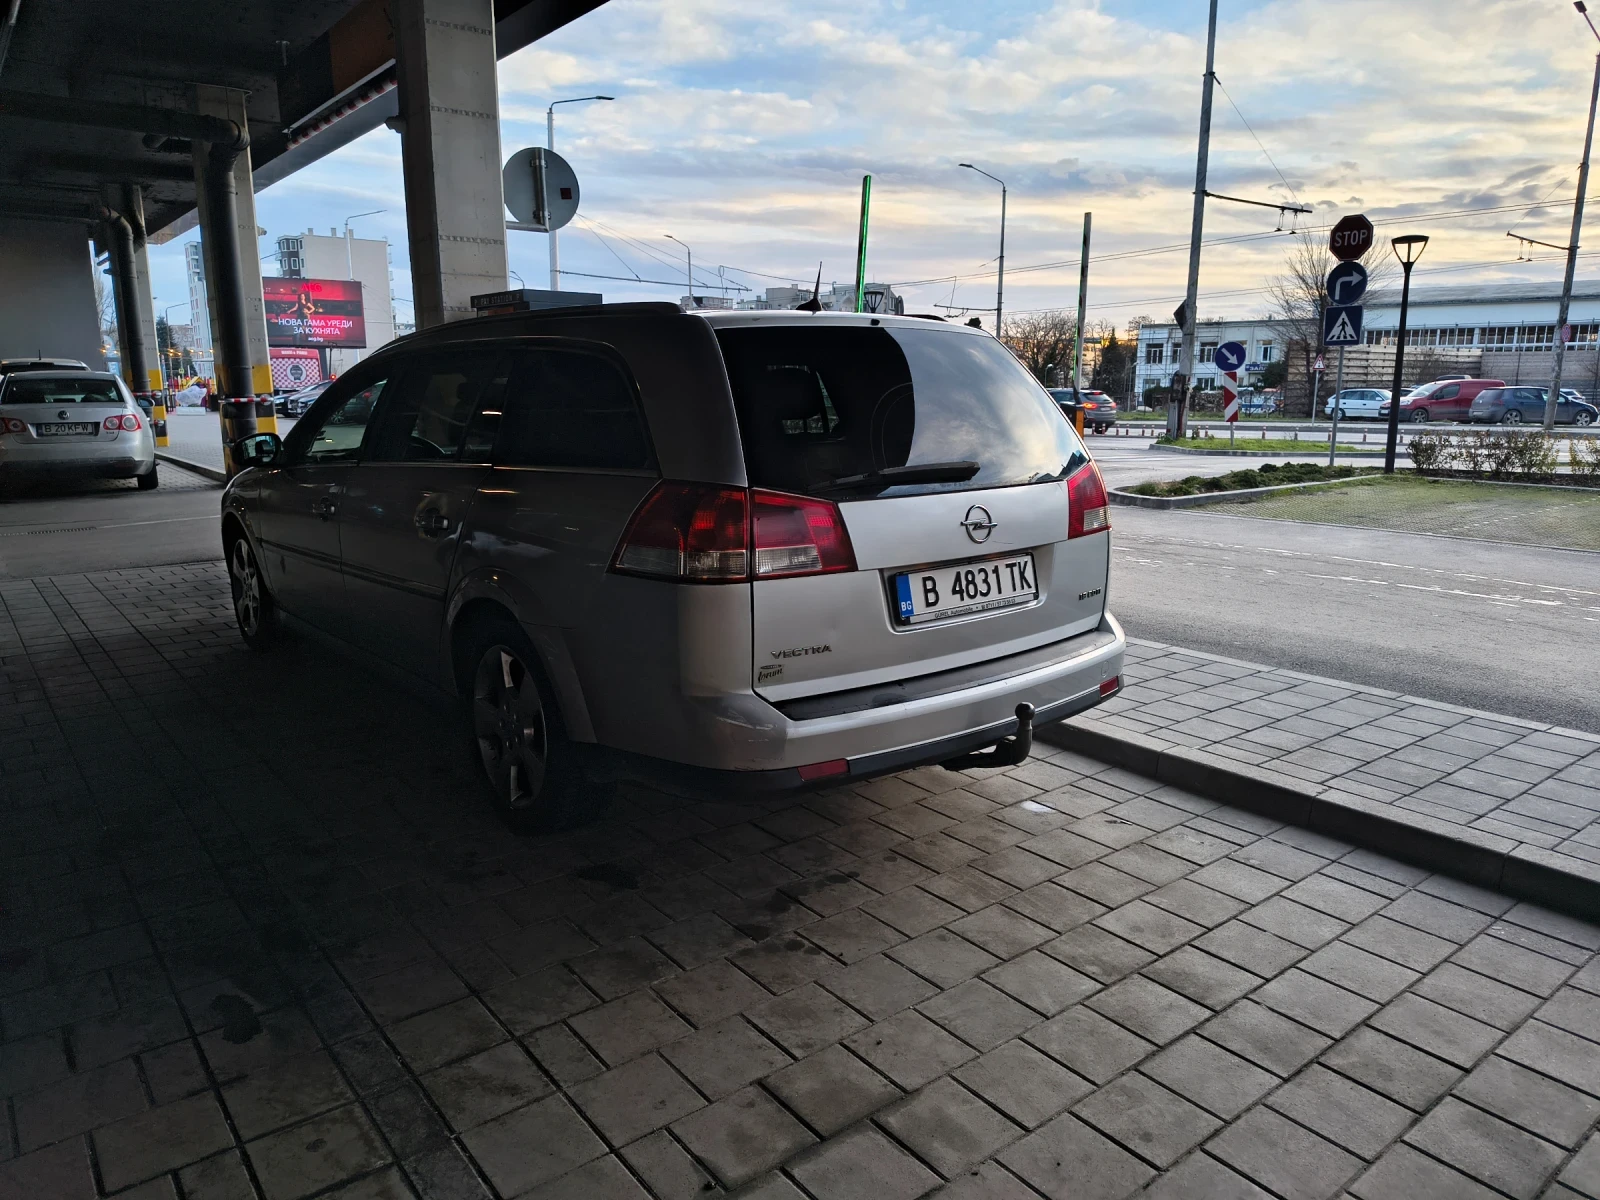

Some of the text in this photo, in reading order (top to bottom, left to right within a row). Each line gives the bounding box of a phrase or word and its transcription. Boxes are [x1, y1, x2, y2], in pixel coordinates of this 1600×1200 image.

[1334, 229, 1368, 247] STOP
[278, 317, 353, 328] НОВА ГАМА УРЕДИ
[293, 326, 340, 335] ЗА КУХНЯТА
[44, 423, 89, 433] B 20 KFW
[922, 560, 1032, 608] B 4831 TK
[901, 601, 912, 611] BG
[770, 643, 832, 660] VECTRA
